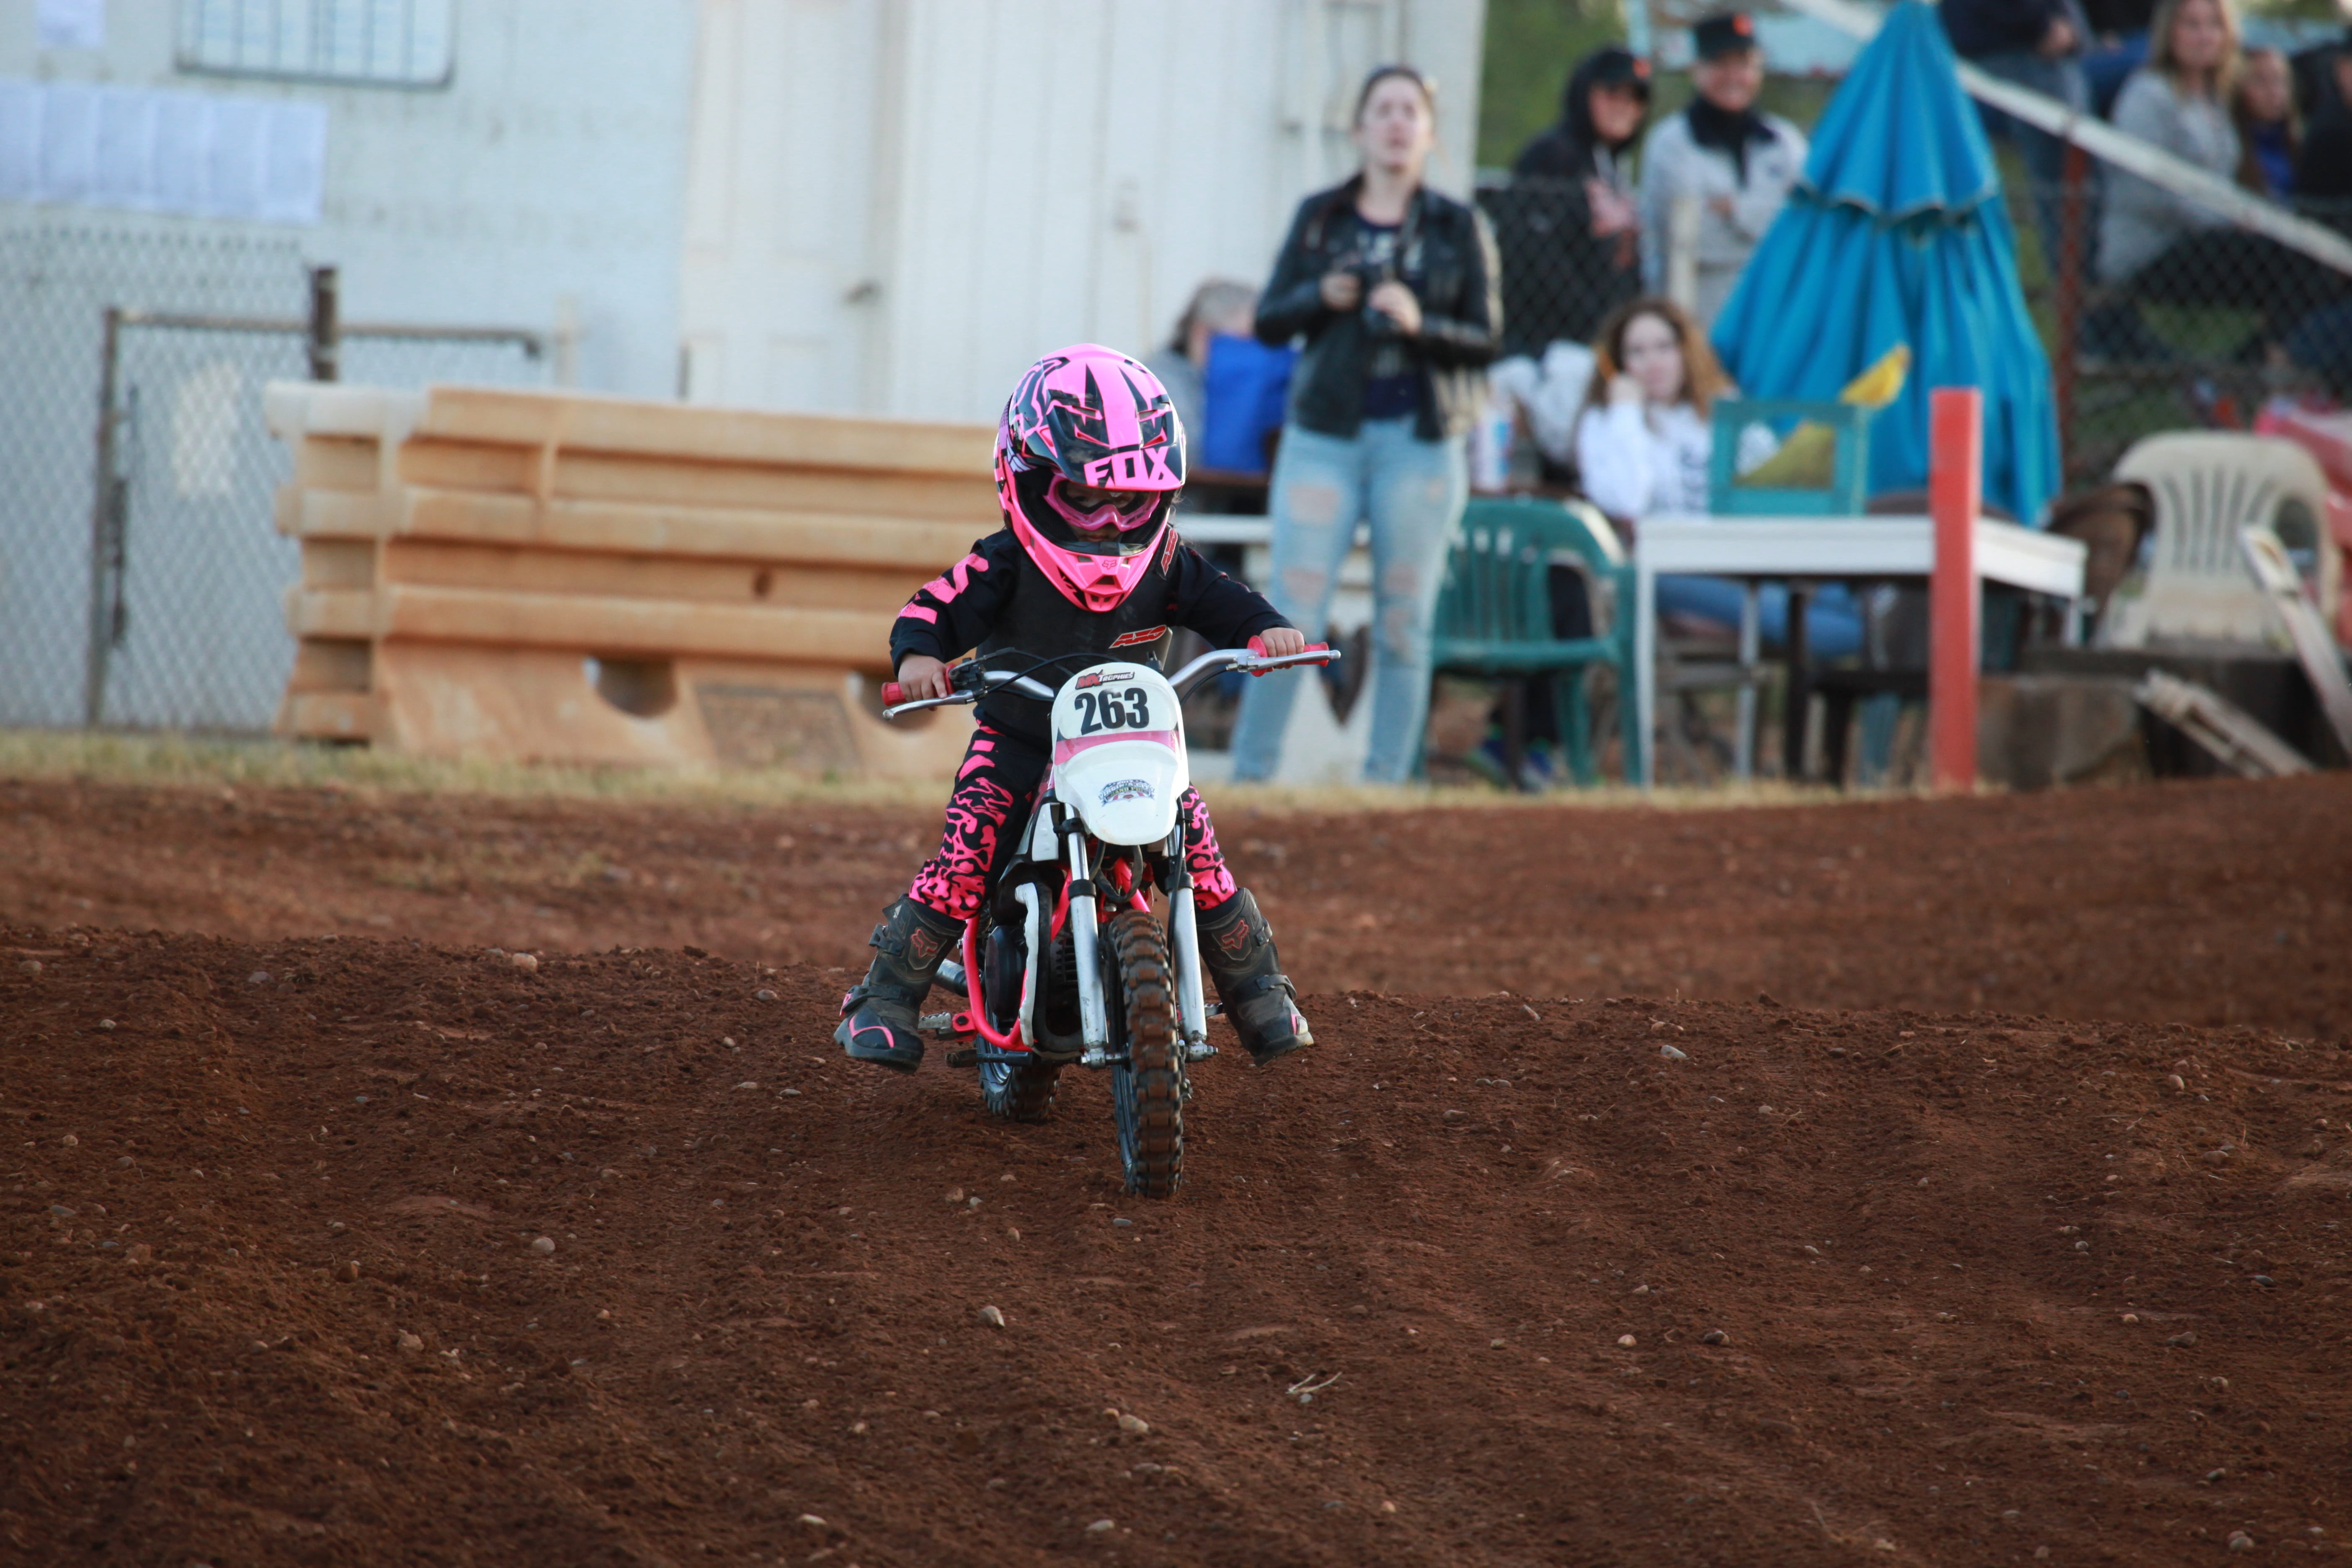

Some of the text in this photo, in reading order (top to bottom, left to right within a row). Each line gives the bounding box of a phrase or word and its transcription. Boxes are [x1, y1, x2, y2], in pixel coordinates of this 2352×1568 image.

[1083, 446, 1181, 490] FOX
[1076, 671, 1104, 689] MX
[1074, 687, 1150, 735] 263
